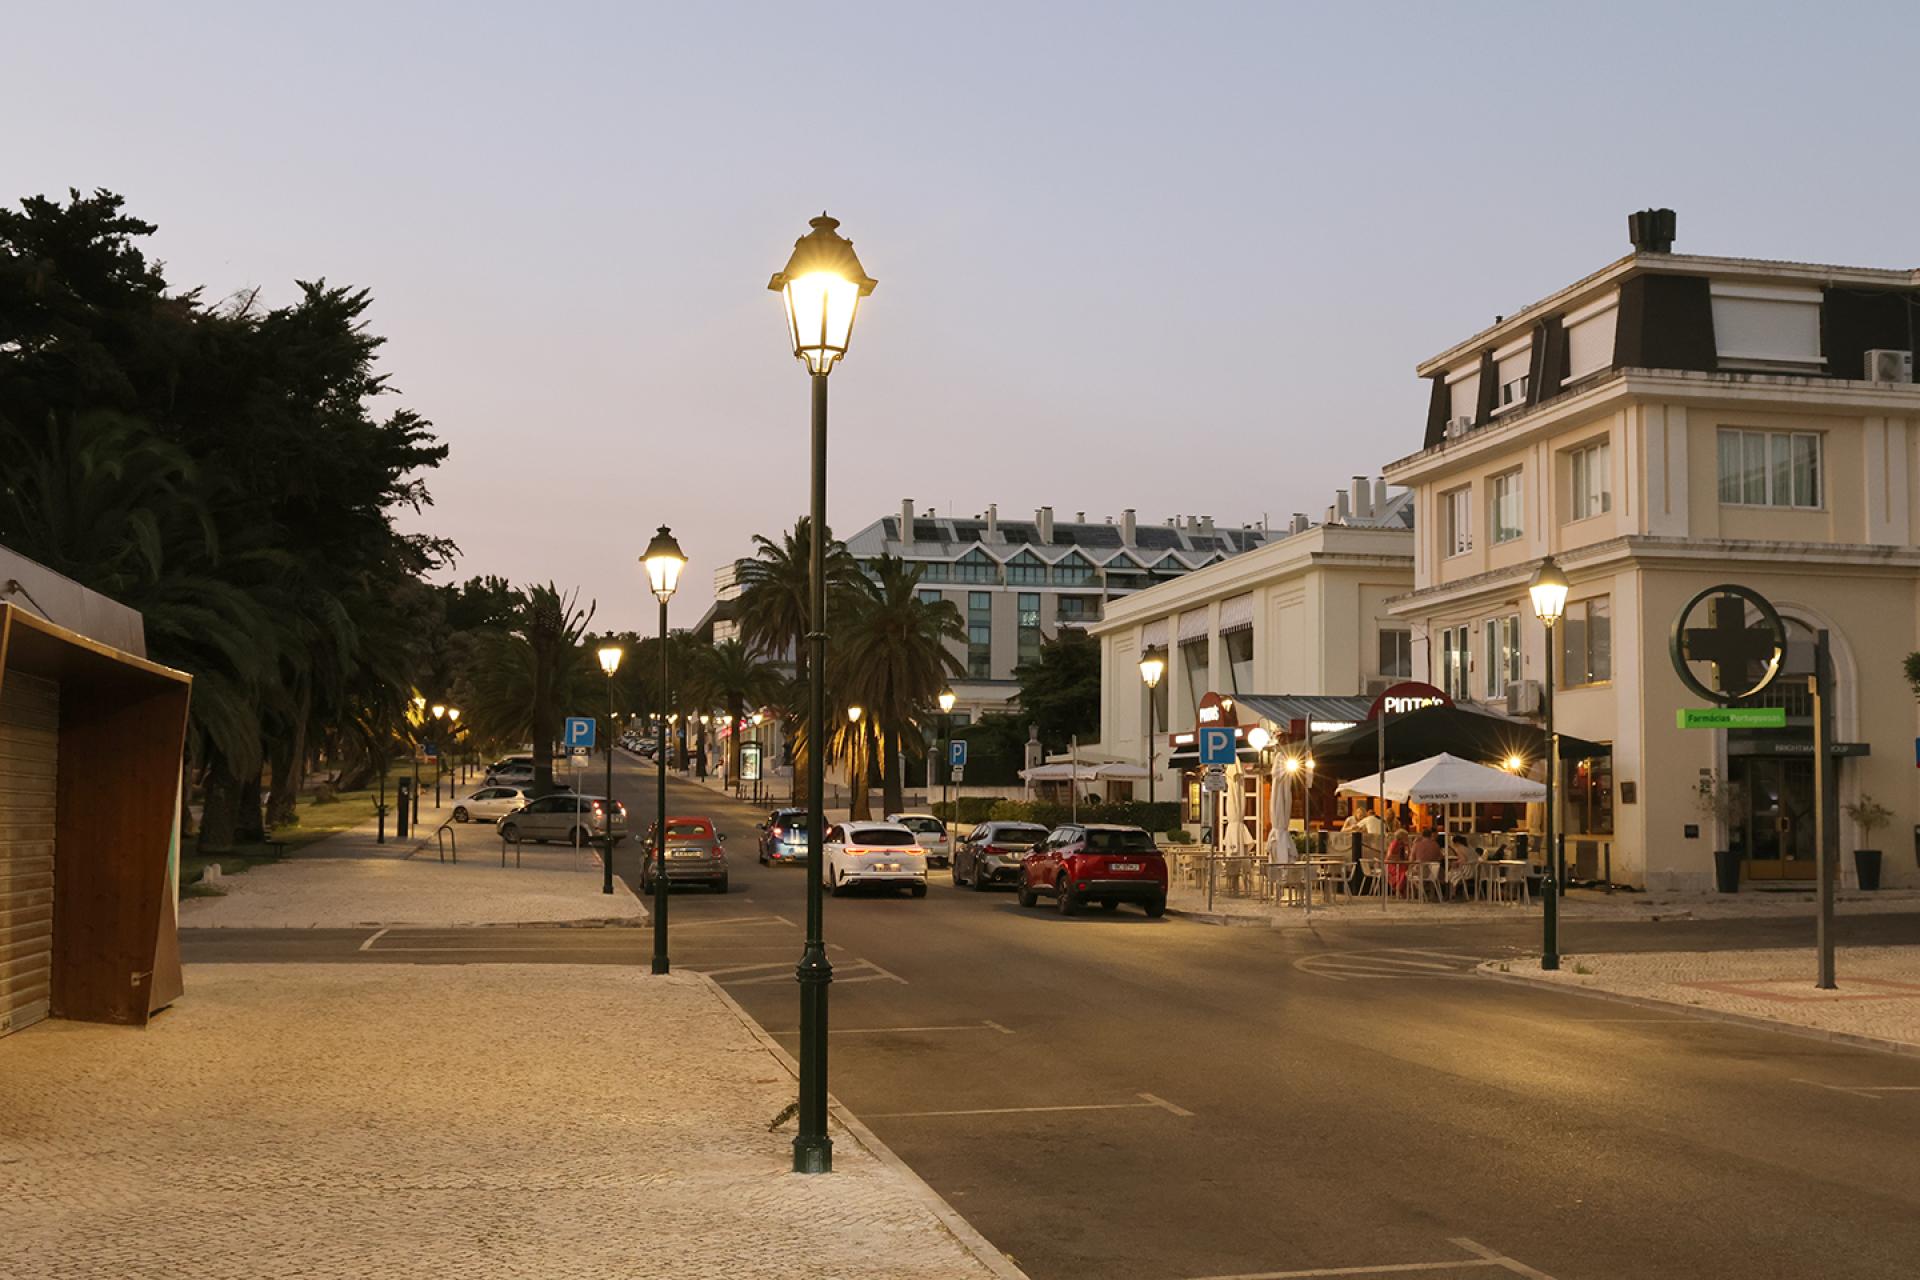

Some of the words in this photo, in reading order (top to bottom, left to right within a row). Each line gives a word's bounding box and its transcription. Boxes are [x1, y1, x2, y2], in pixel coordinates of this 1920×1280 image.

[572, 721, 589, 743] P
[953, 744, 962, 762] P
[1208, 732, 1228, 760] P
[1775, 744, 1814, 752] BRIGHTMA
